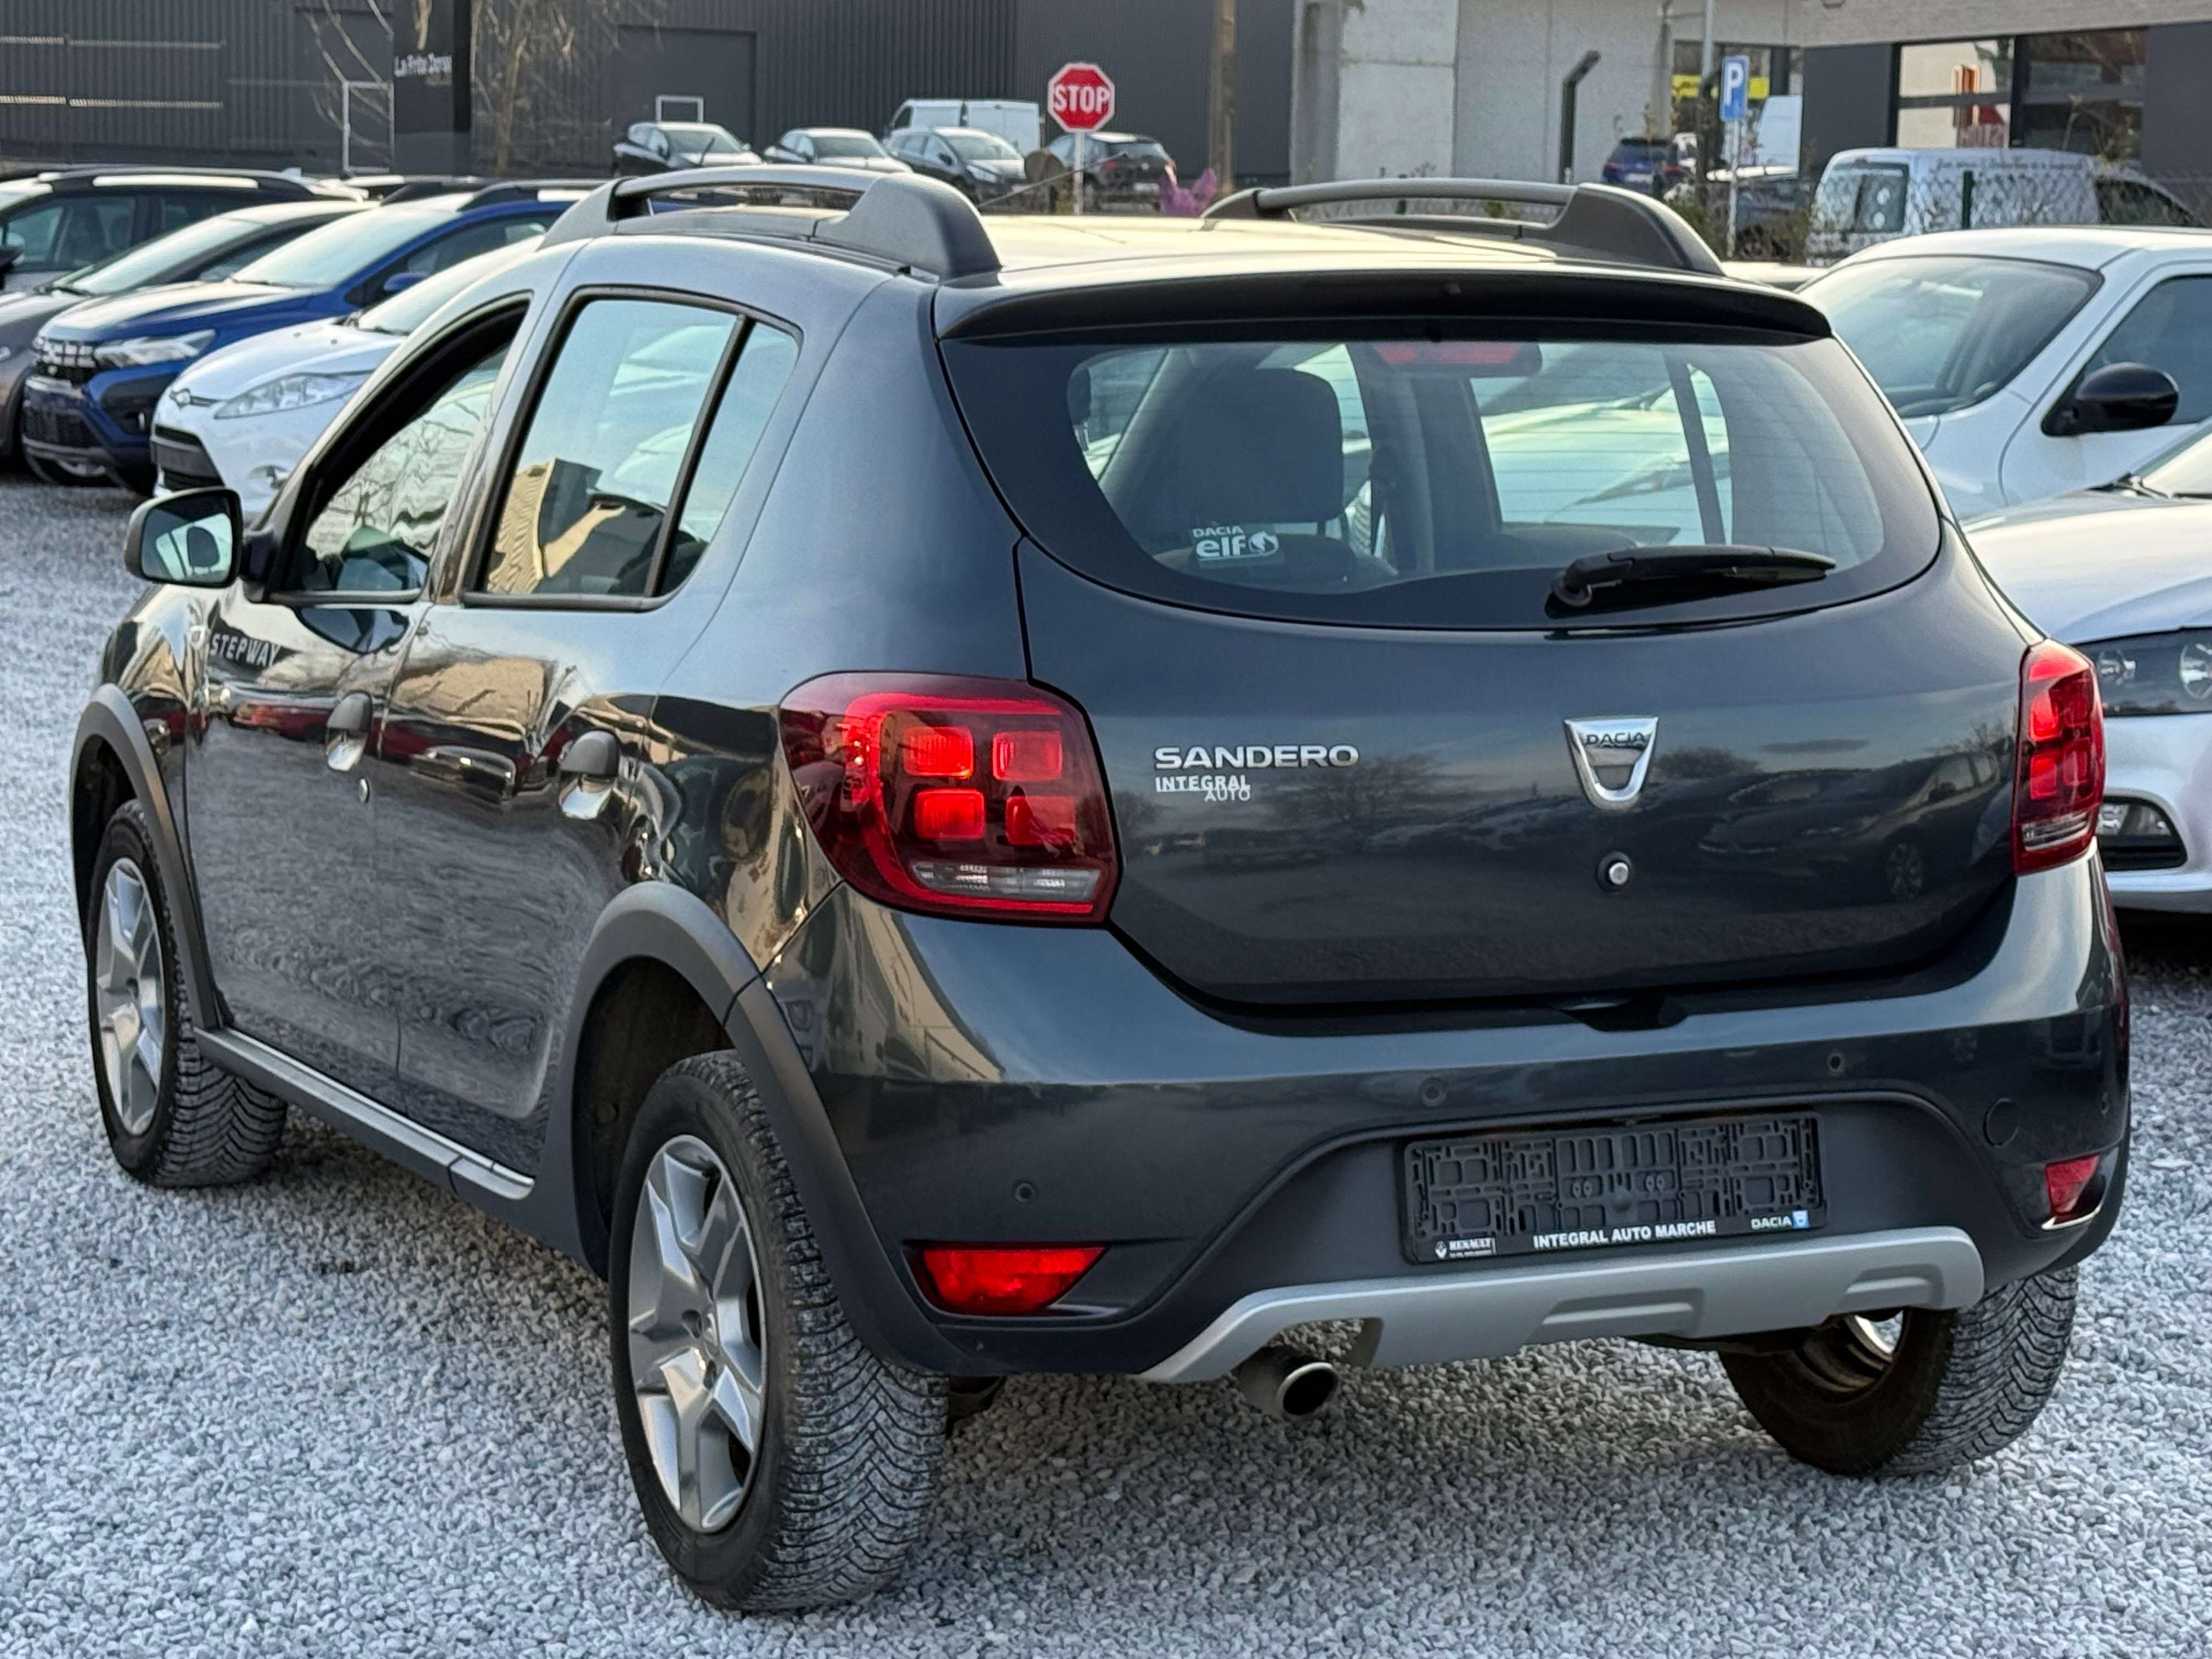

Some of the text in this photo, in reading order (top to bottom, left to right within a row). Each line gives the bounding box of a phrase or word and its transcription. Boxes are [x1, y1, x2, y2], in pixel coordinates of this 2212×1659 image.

[1723, 62, 1744, 106] P
[1053, 84, 1110, 114] STOP
[1192, 525, 1244, 538] DACIA
[1196, 535, 1246, 558] elf
[210, 633, 282, 667] STEPWAY
[1584, 731, 1646, 747] DACIA
[1155, 744, 1359, 769] SANDERO
[1155, 774, 1251, 793] INTEGRAL
[1204, 788, 1251, 802] AUTO
[1751, 1215, 1792, 1230] DACIA
[1533, 1220, 1716, 1249] INTEGRAL AUTO MARCHE
